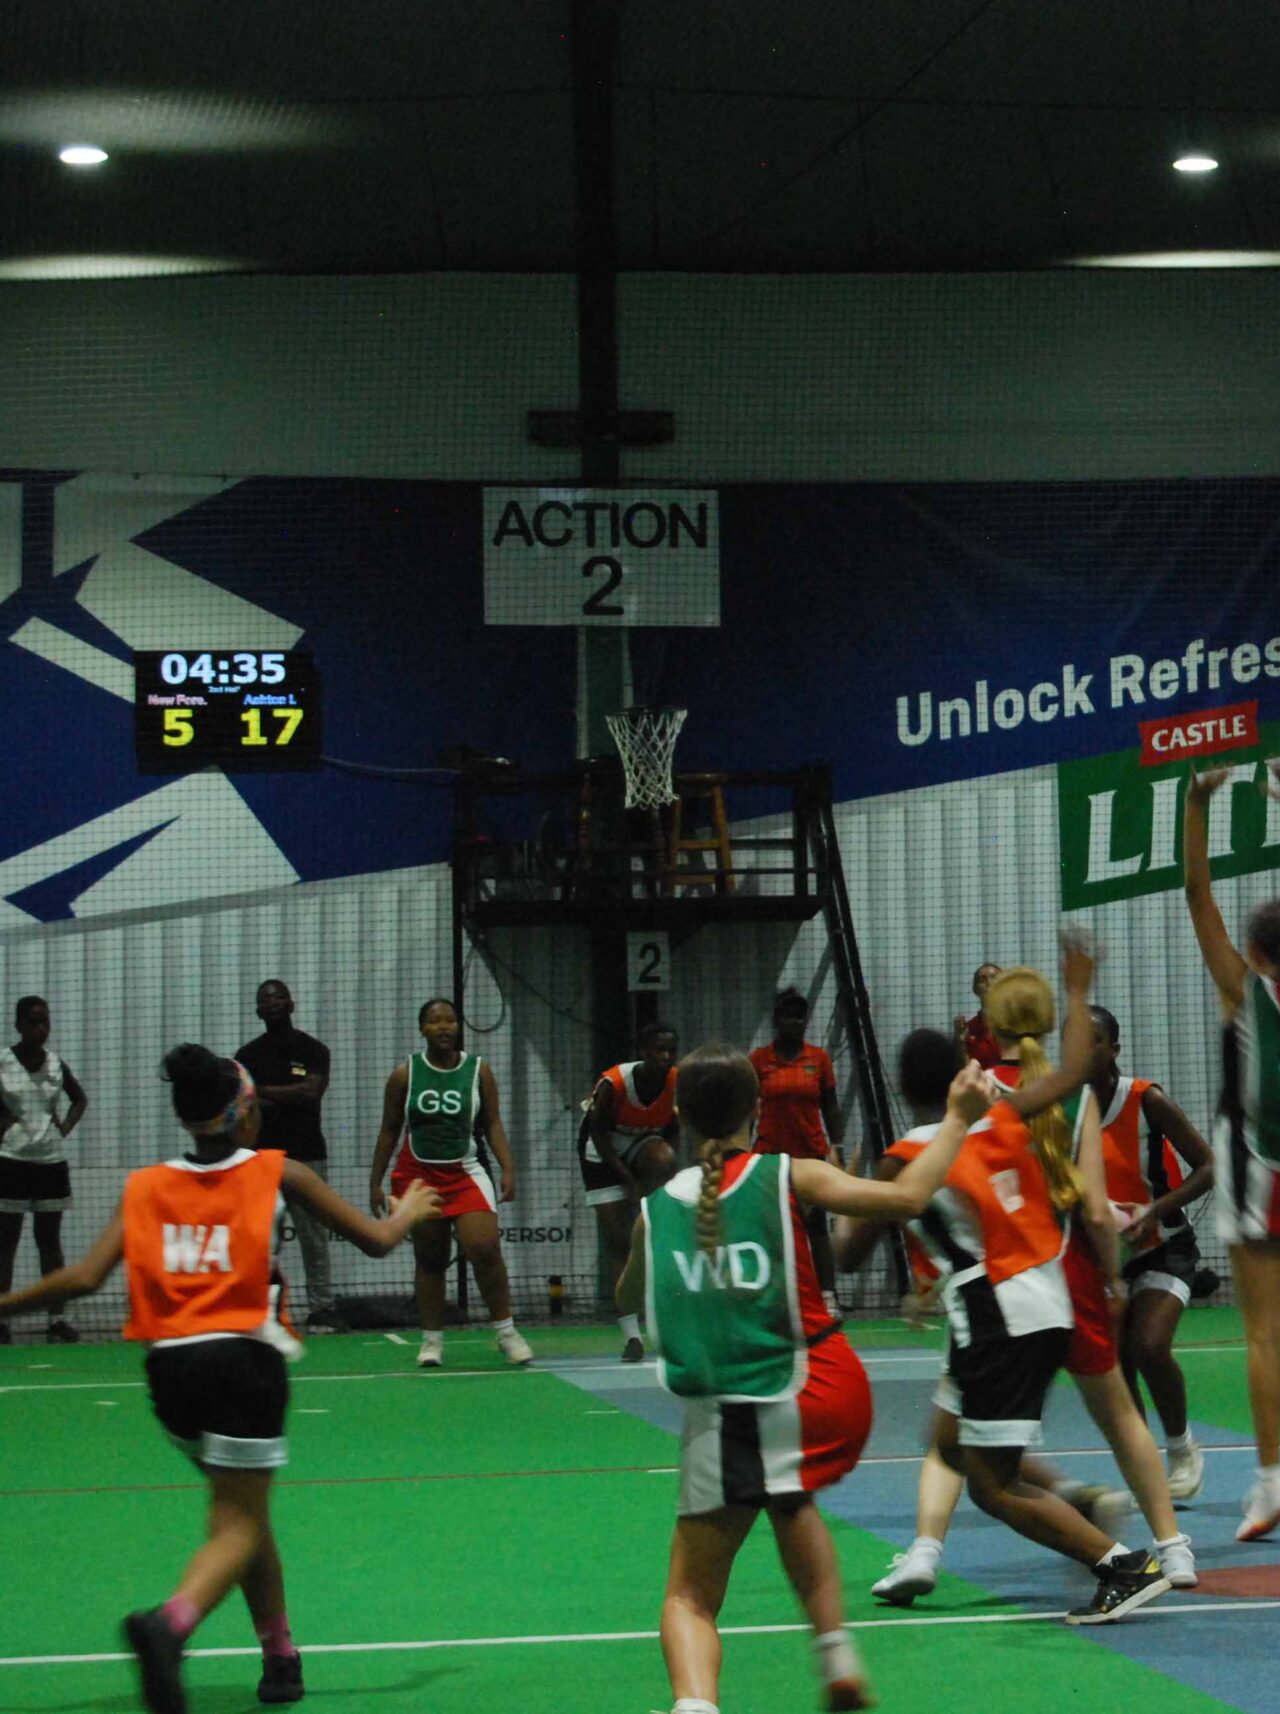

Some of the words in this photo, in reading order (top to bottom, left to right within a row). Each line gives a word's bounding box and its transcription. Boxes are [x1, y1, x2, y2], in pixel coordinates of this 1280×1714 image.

[493, 500, 708, 548] ACTION
[582, 555, 624, 616] 2
[161, 653, 286, 684] 04:35
[896, 663, 1096, 747] Unlock
[162, 708, 195, 747] 5
[241, 708, 304, 746] 17
[1151, 714, 1248, 752] CASTLE
[639, 942, 662, 984] 2
[417, 1089, 462, 1115] GS
[162, 1223, 234, 1273] WA
[672, 1240, 771, 1293] WD
